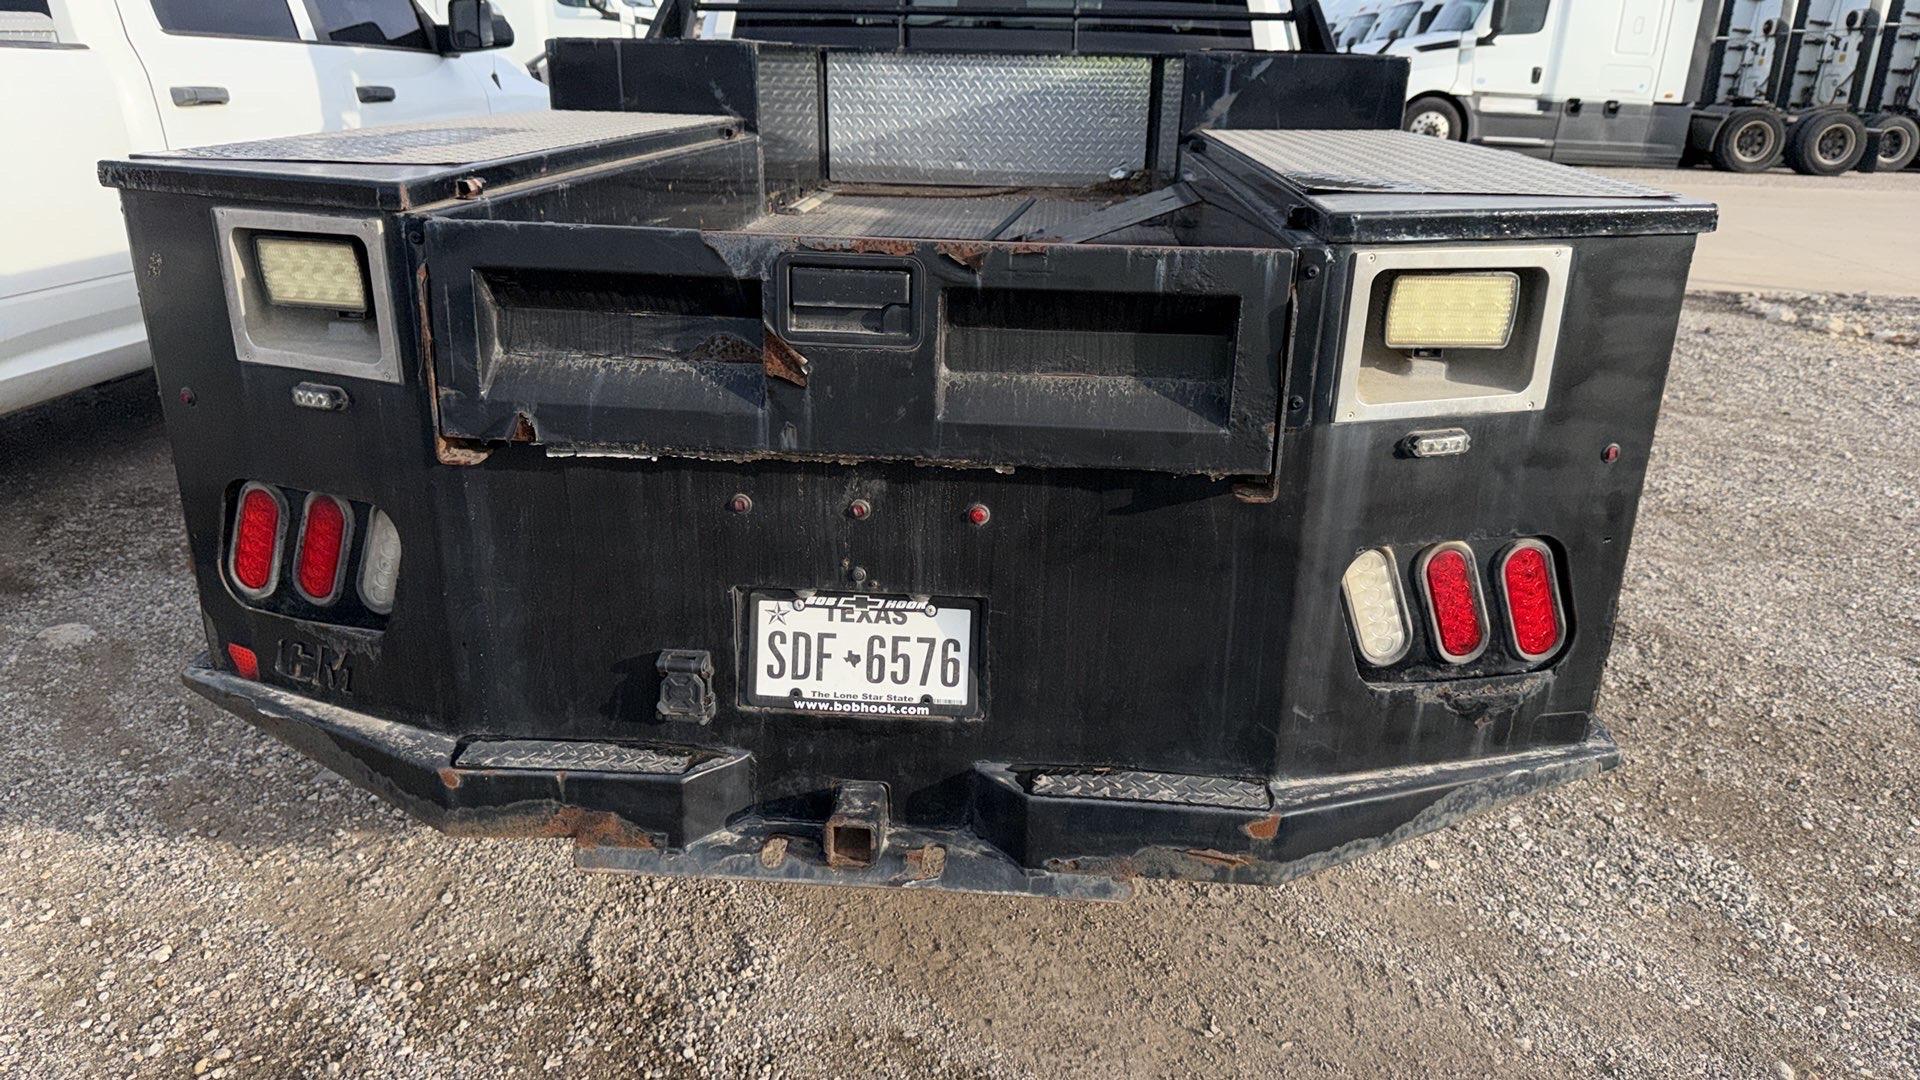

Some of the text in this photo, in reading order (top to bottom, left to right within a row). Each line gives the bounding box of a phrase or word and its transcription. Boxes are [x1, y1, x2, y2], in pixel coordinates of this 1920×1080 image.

[805, 596, 929, 610] BOB HOOK
[827, 608, 908, 625] TEXAS
[767, 630, 961, 688] SDF 6576
[810, 690, 914, 702] The Lone Star State
[794, 700, 930, 715] www.bobhook.com
